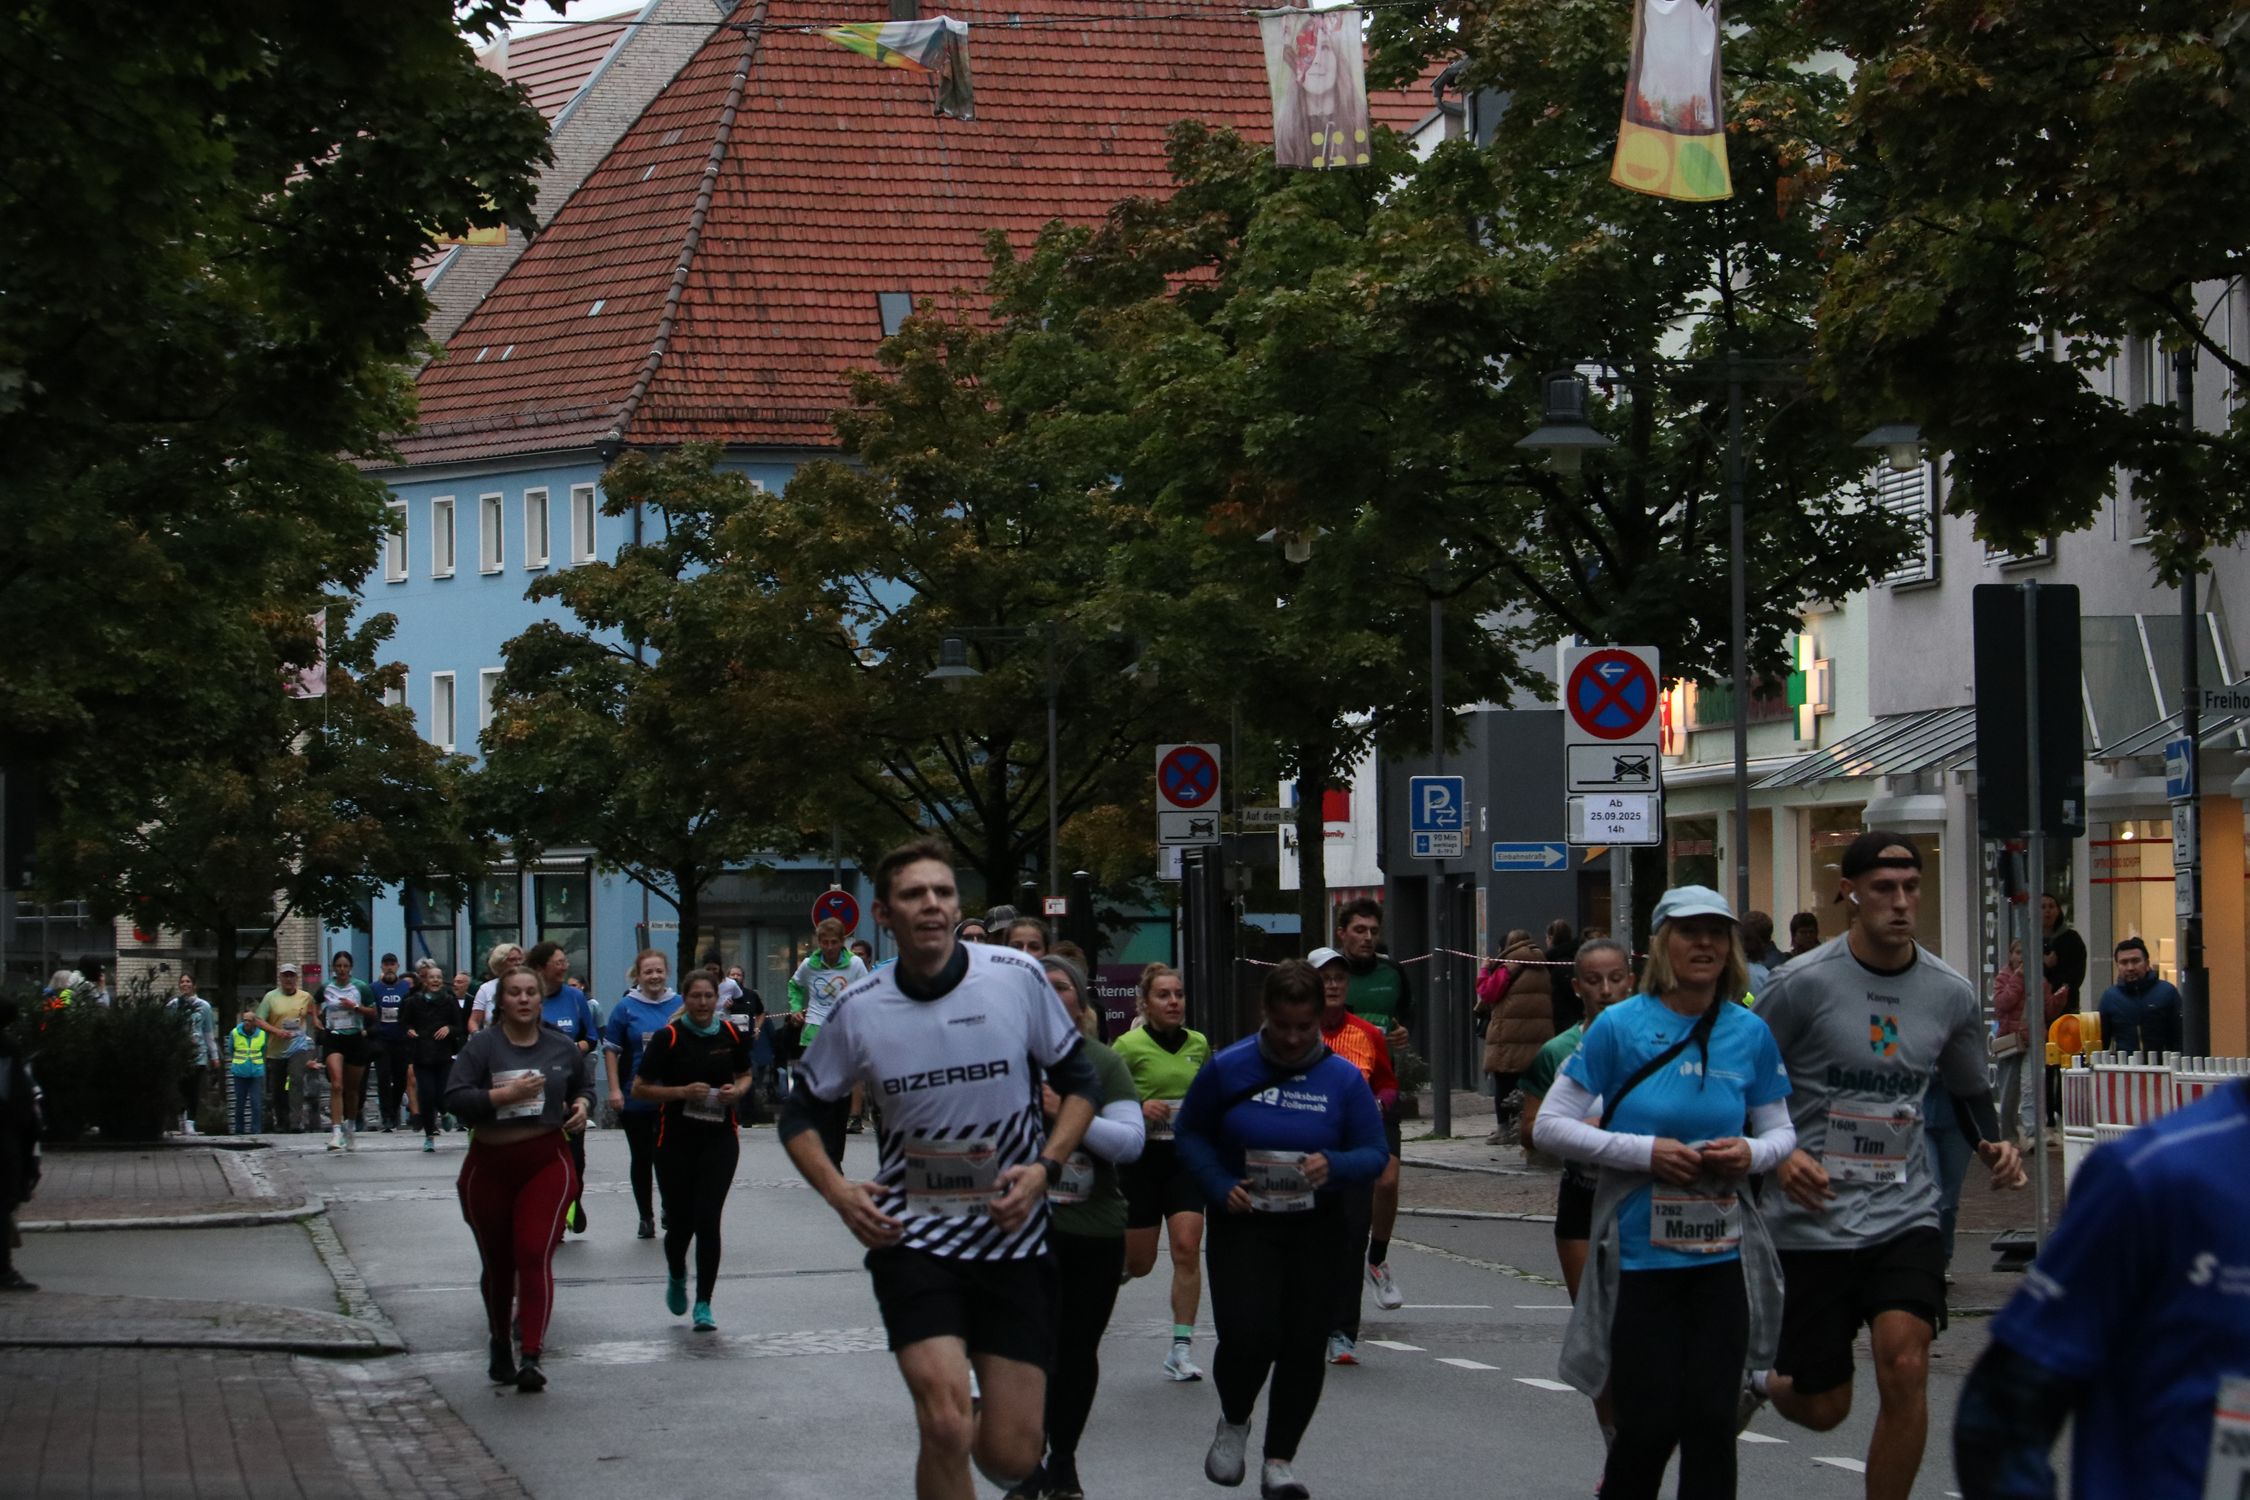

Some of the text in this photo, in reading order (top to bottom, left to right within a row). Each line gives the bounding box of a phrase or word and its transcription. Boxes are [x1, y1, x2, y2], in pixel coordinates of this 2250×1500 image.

[2205, 690, 2250, 709] Freiho
[1609, 799, 1623, 807] Ab
[1246, 811, 1260, 821] Auf
[1263, 811, 1280, 821] dem
[1590, 812, 1641, 821] 25.09.2025
[1607, 825, 1625, 833] 14h
[883, 1060, 1009, 1096] BIZERBA
[1282, 1089, 1328, 1104] Volksbank
[1280, 1099, 1327, 1113] Zollernalb
[1831, 1119, 1857, 1132] 1605
[1853, 1136, 1884, 1154] Tim
[925, 1172, 974, 1190] Liam
[1262, 1176, 1298, 1191] Julia
[1655, 1204, 1682, 1216] 1262
[1665, 1219, 1727, 1242] Margit
